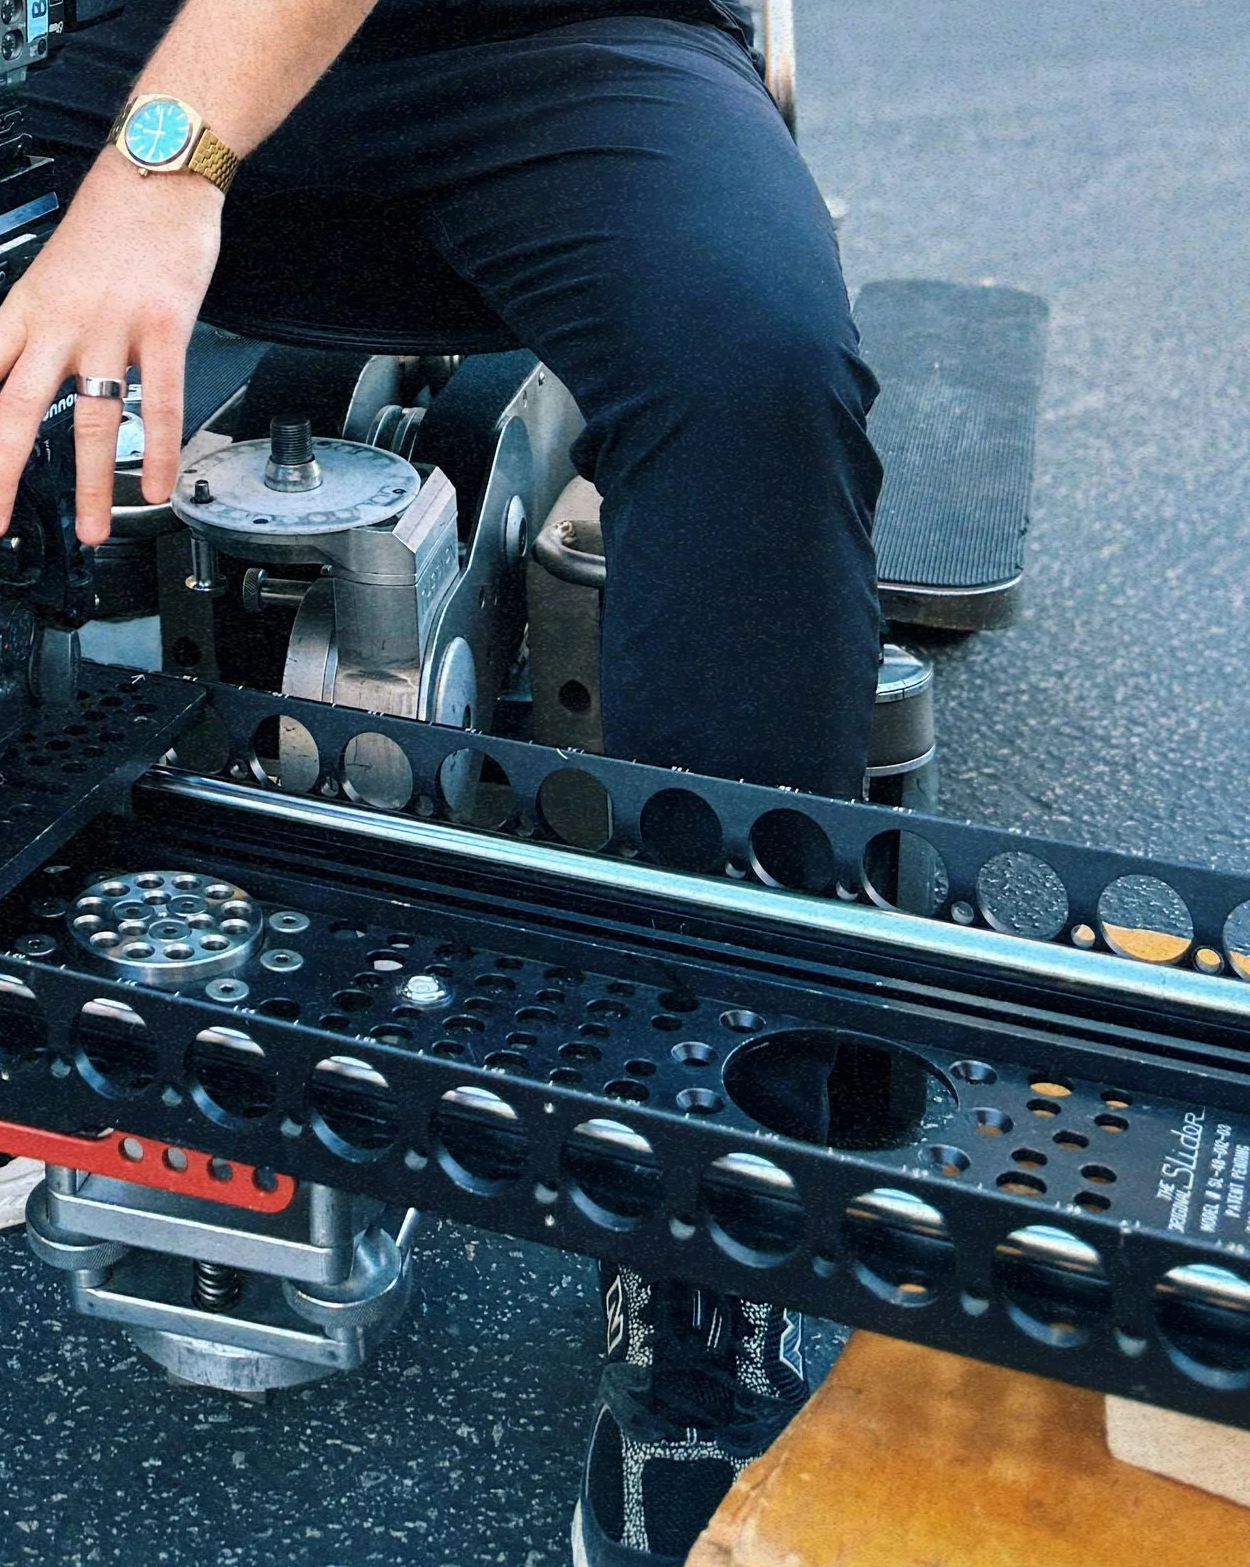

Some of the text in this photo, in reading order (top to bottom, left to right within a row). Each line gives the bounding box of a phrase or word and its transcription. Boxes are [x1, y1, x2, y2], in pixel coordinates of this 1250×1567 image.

[1155, 1179, 1176, 1202] THE
[1224, 1144, 1250, 1219] PATENT PENDING
[1200, 1203, 1221, 1233] MODEL
